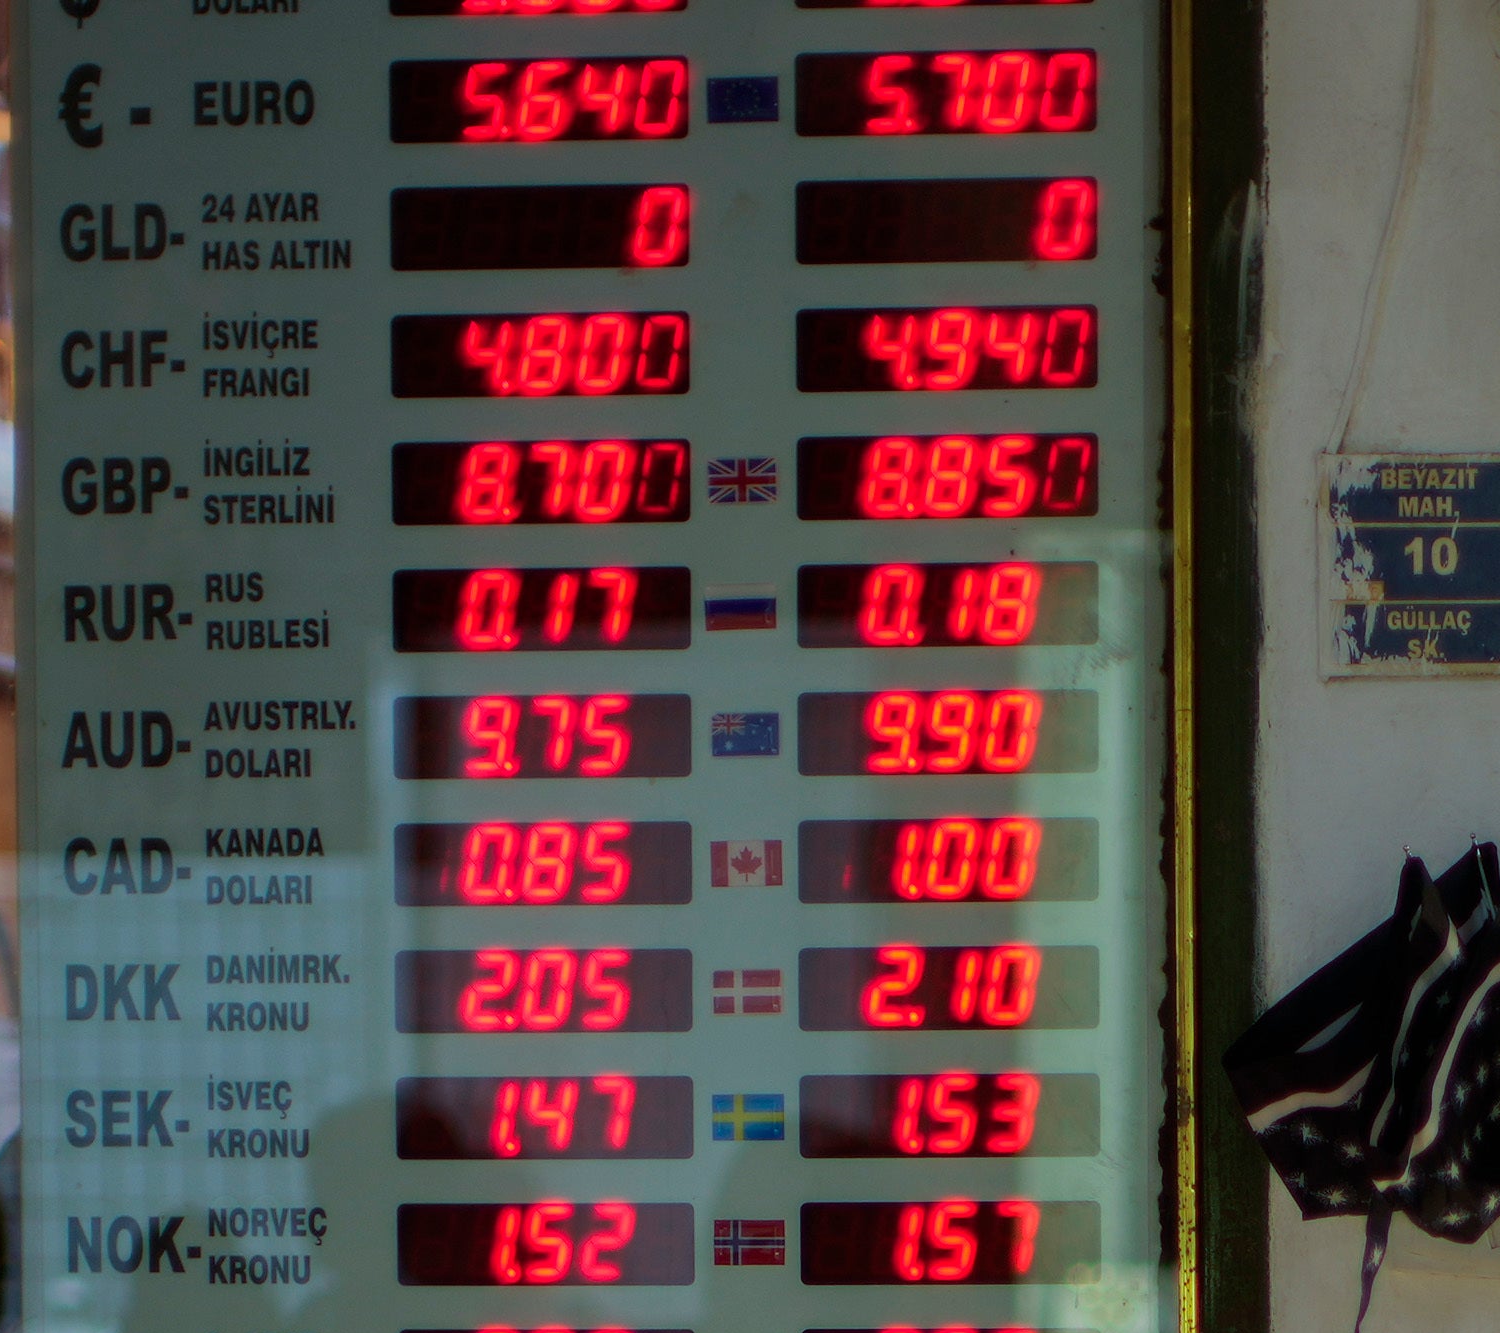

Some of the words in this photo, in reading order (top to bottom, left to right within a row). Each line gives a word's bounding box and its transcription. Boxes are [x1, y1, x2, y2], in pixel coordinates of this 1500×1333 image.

[192, 81, 315, 126] EURO
[202, 193, 236, 223] 24
[244, 192, 320, 224] AYAR
[630, 186, 688, 264] 0
[1036, 178, 1094, 260] 0
[60, 203, 185, 262] GLD-
[202, 240, 263, 271] HAS
[270, 239, 352, 271] ALTIN
[202, 309, 319, 360] İSVİÇRE
[60, 330, 187, 387] CHF-
[203, 367, 310, 398] FRANGI
[203, 439, 310, 478] İNGİLİZ
[62, 457, 188, 515] GBP-
[1380, 469, 1478, 489] BEYAZIT
[204, 486, 335, 525] STERLİNİ
[1398, 497, 1460, 517] MAH.
[1404, 537, 1459, 576] 10
[205, 571, 264, 604] RUS
[63, 585, 193, 641] RUR-
[206, 609, 331, 651] RUBLESİ
[1387, 605, 1472, 635] GÜLLAÇ
[1407, 641, 1446, 658] SK.
[204, 699, 357, 733] AVUSTRLY.
[62, 710, 192, 769] AUD-
[204, 748, 312, 779] DOLARI
[204, 827, 324, 858] KANADA
[63, 837, 192, 895] CAD-
[205, 874, 313, 906] DOLARI
[205, 947, 351, 985] DANİMRK.
[65, 964, 179, 1021] DKK
[205, 1000, 310, 1032] KRONU
[205, 1074, 292, 1118] İSVEÇ
[65, 1090, 189, 1149] SEK-
[206, 1127, 310, 1158] KRONU
[67, 1216, 202, 1274] NOK-
[206, 1208, 328, 1247] NORVEÇ
[207, 1253, 311, 1285] KRONU
